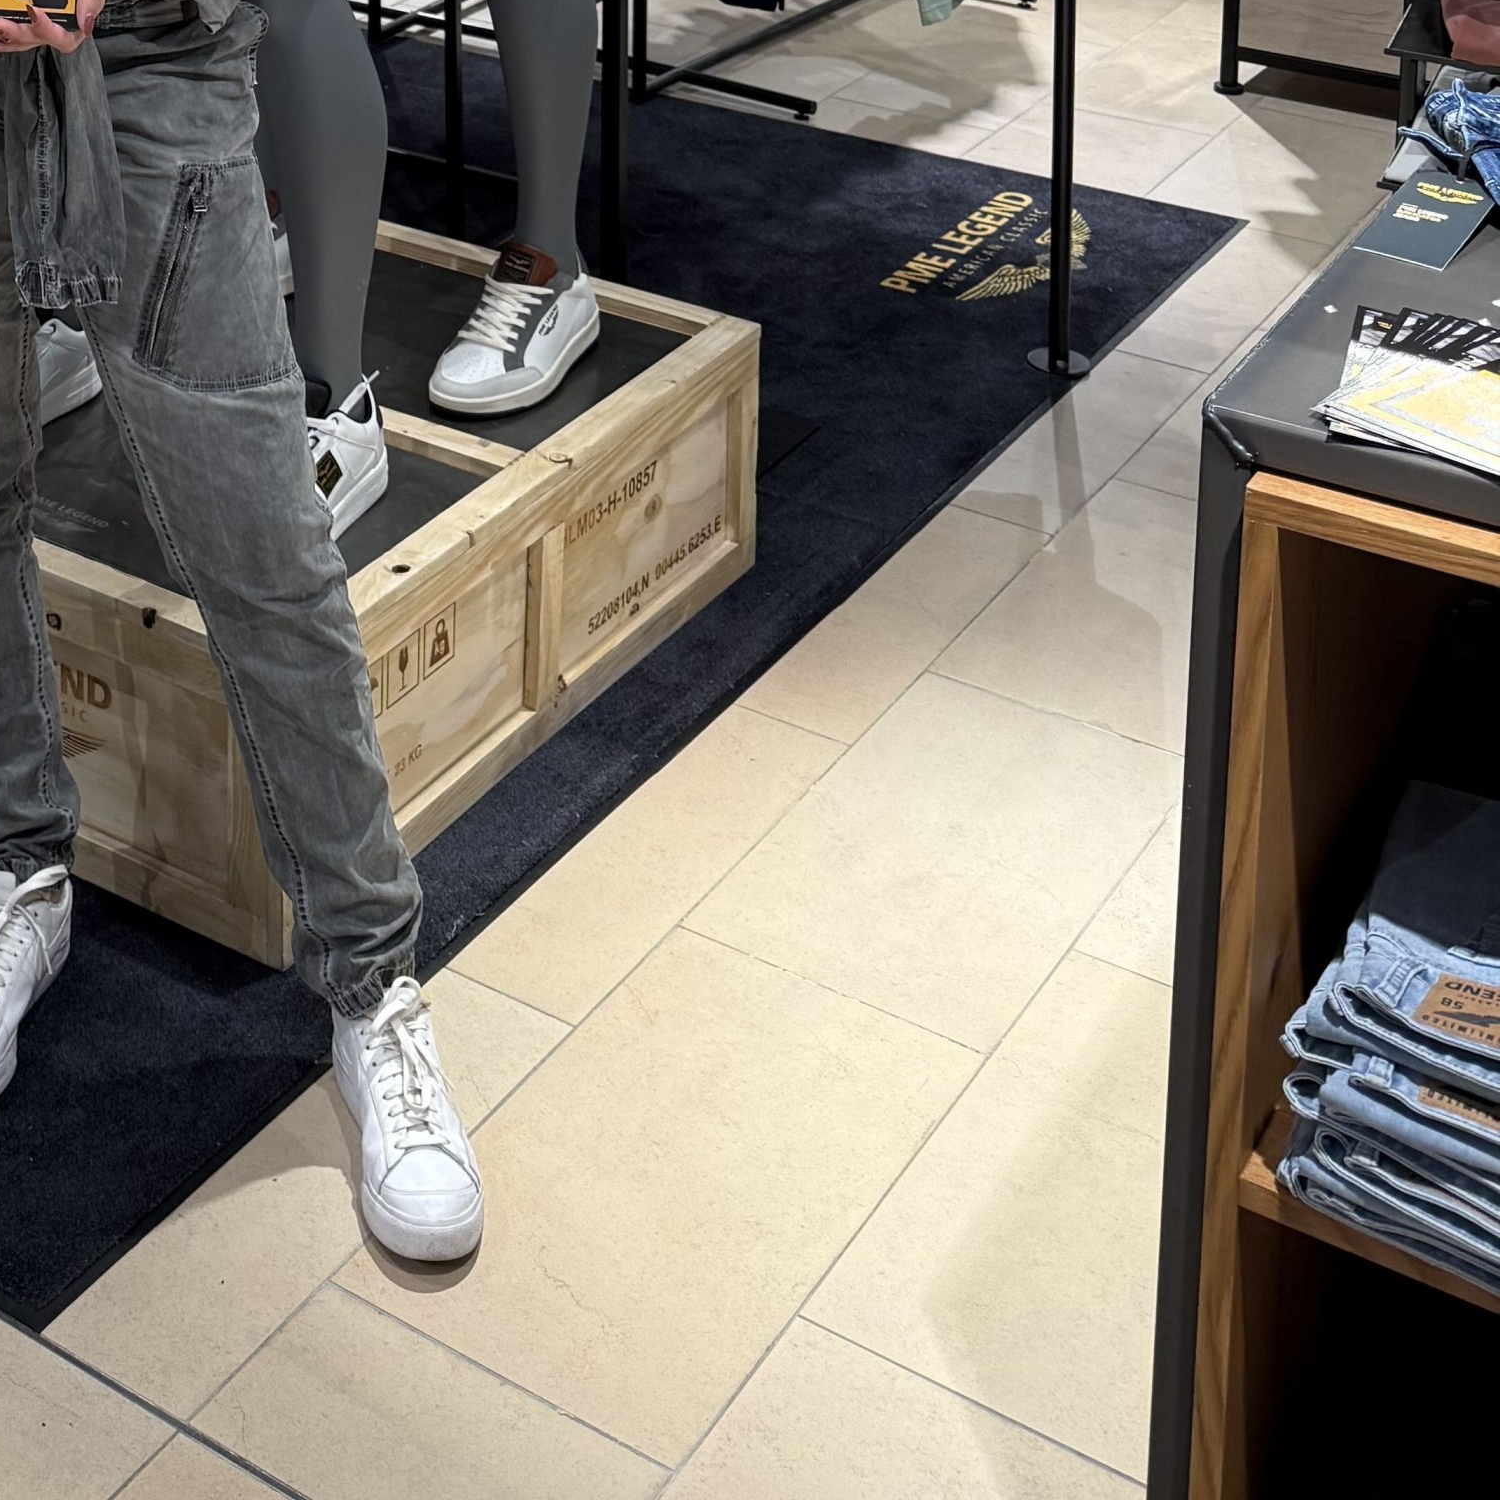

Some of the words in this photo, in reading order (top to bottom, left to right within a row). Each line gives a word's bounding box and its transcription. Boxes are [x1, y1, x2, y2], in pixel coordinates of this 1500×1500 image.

[880, 251, 956, 294] PME
[931, 191, 1033, 255] LEGEND
[943, 243, 1005, 289] AMERICAN
[1000, 207, 1049, 242] CLASSIC
[407, 744, 422, 766] KG
[1444, 981, 1500, 1000] END
